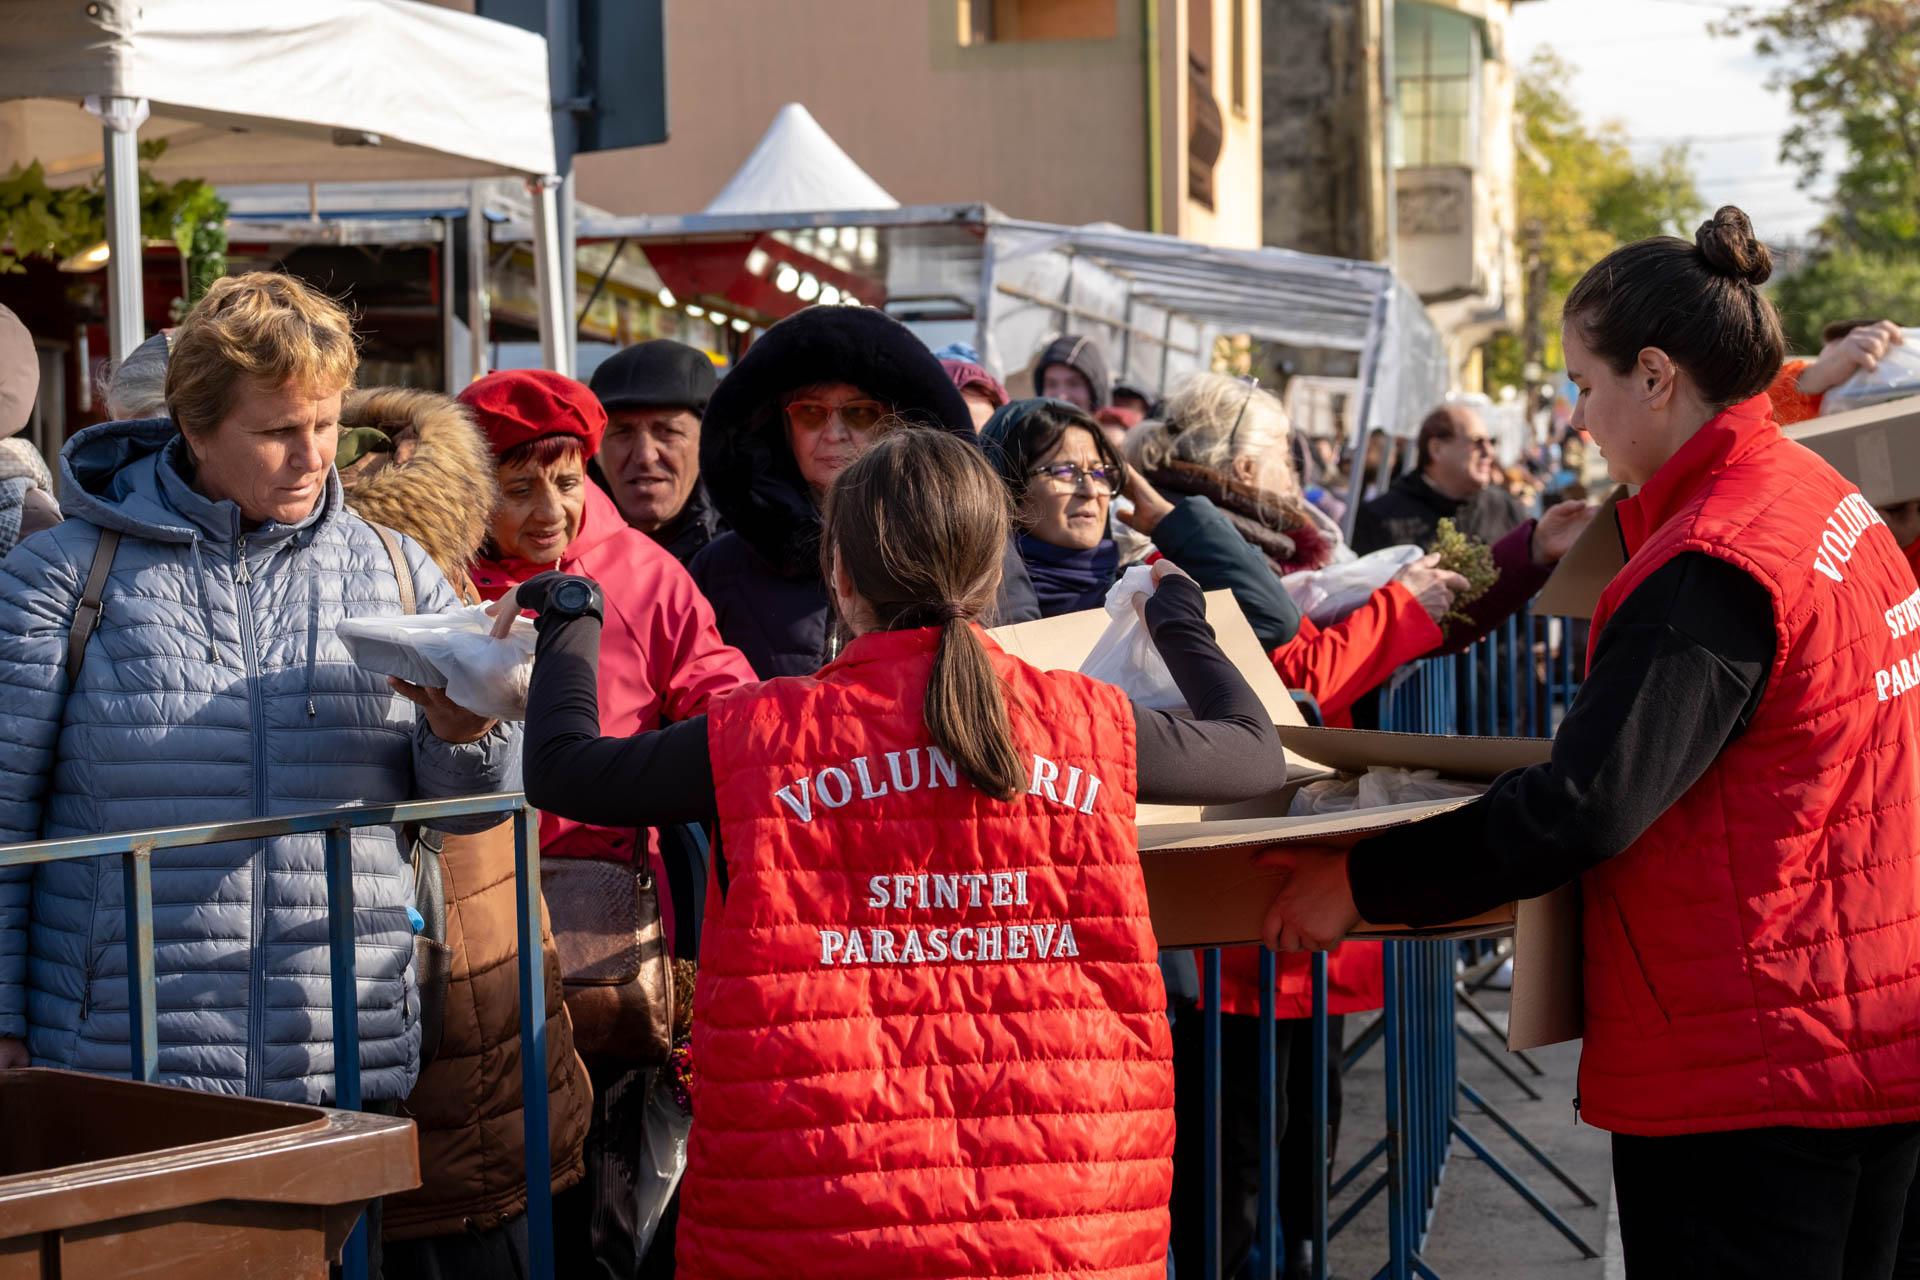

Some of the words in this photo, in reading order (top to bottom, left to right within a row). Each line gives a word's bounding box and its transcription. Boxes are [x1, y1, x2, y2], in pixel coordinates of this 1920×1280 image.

[1813, 492, 1887, 583] VOLUNT
[1875, 649, 1920, 702] PARA
[775, 746, 1102, 823] VOLUNRII
[869, 871, 1028, 909] SFINTEI
[819, 923, 1079, 965] PARASCHEVA
